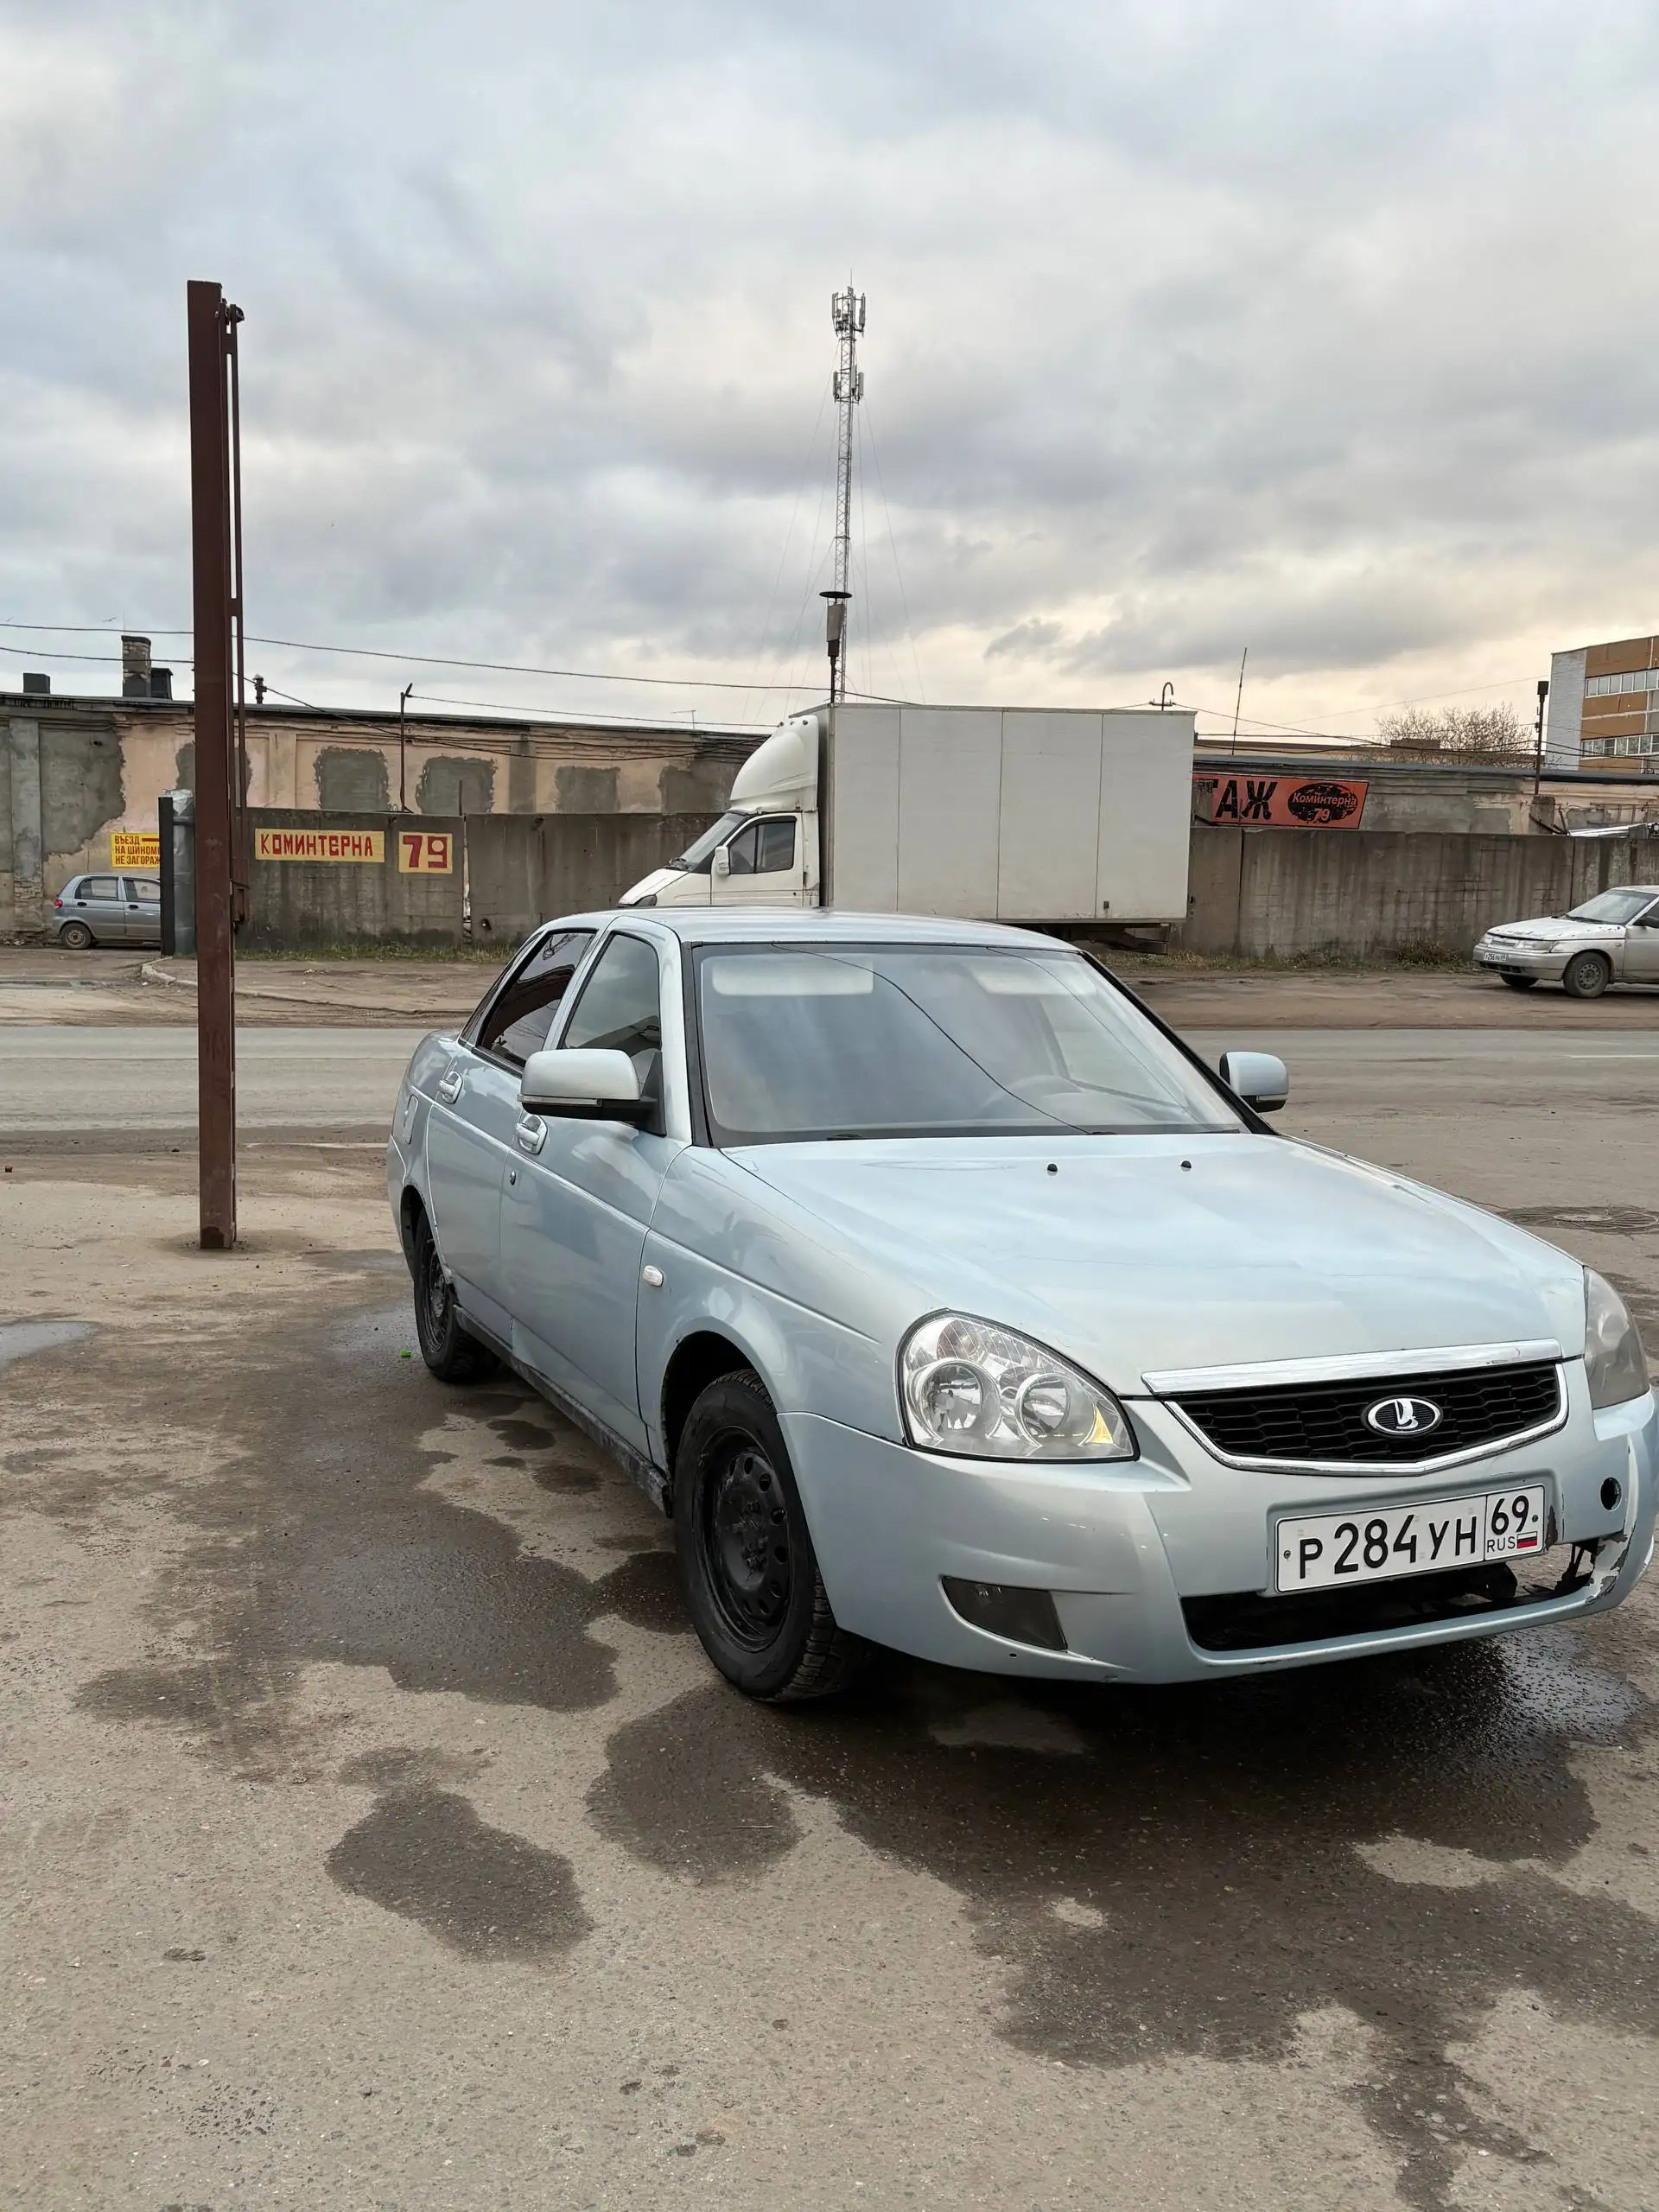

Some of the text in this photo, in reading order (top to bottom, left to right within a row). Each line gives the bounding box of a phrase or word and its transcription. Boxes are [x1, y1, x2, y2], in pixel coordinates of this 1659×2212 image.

[1293, 791, 1357, 806] Коминтерна
[1313, 808, 1332, 822] 79
[115, 845, 125, 855] НА
[261, 833, 372, 857] КОМИНТЕРНА
[403, 835, 448, 868] 79
[115, 855, 125, 865] НЕ
[1299, 1495, 1529, 1580] Р284УН 69
[1486, 1534, 1516, 1554] RUS
